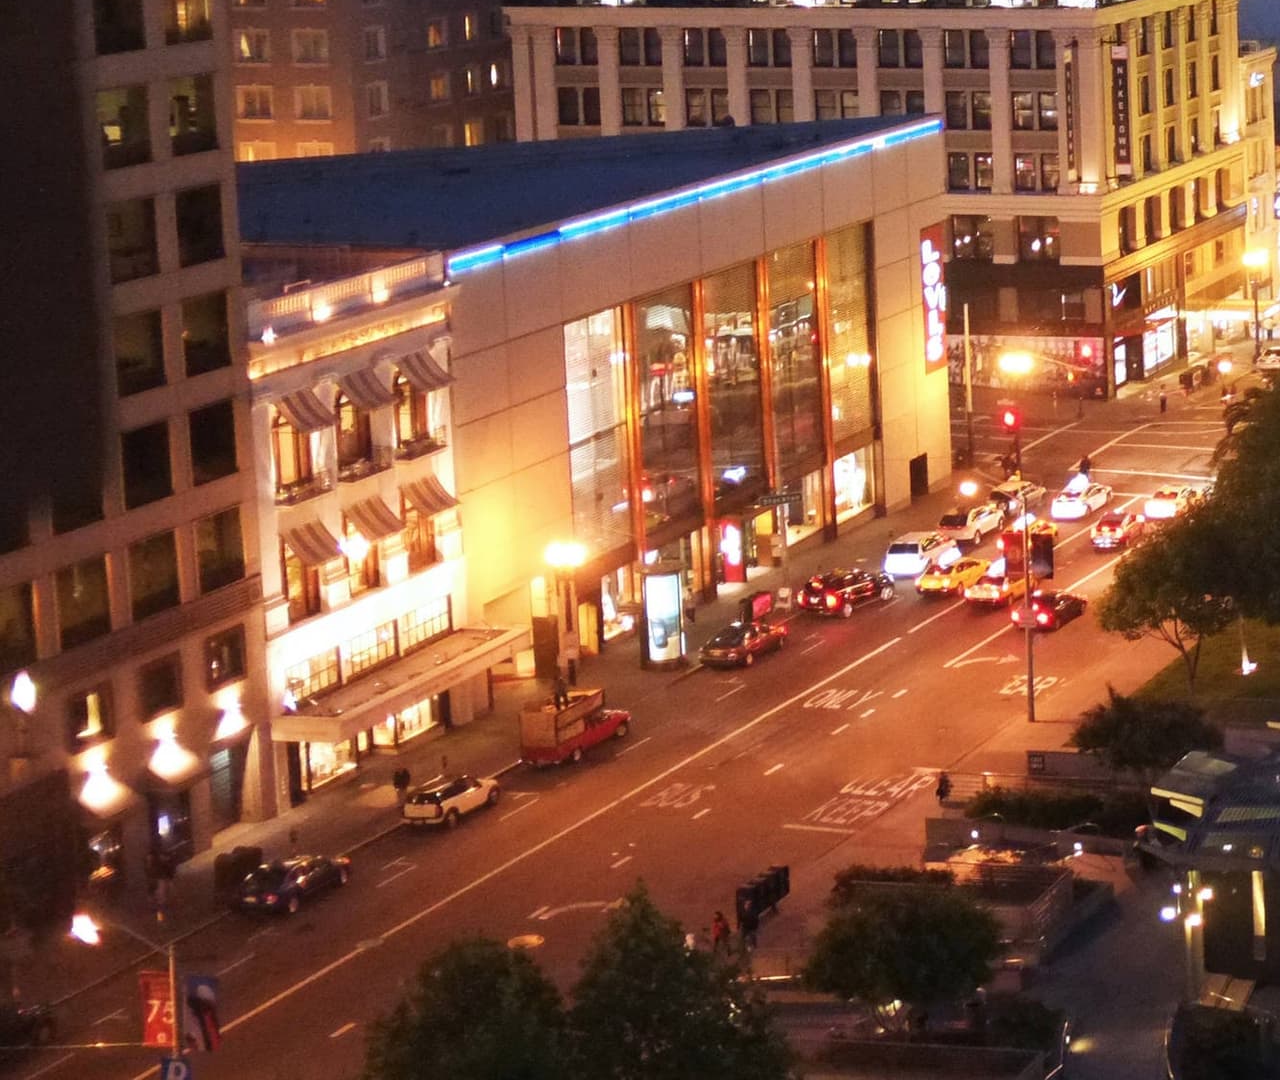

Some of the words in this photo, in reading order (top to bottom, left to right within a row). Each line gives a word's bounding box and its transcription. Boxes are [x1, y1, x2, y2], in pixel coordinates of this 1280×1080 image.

[1116, 66, 1127, 157] NIKETOWN
[803, 689, 884, 710] ONLY
[840, 773, 936, 799] CLEAR
[803, 796, 889, 824] KEEP
